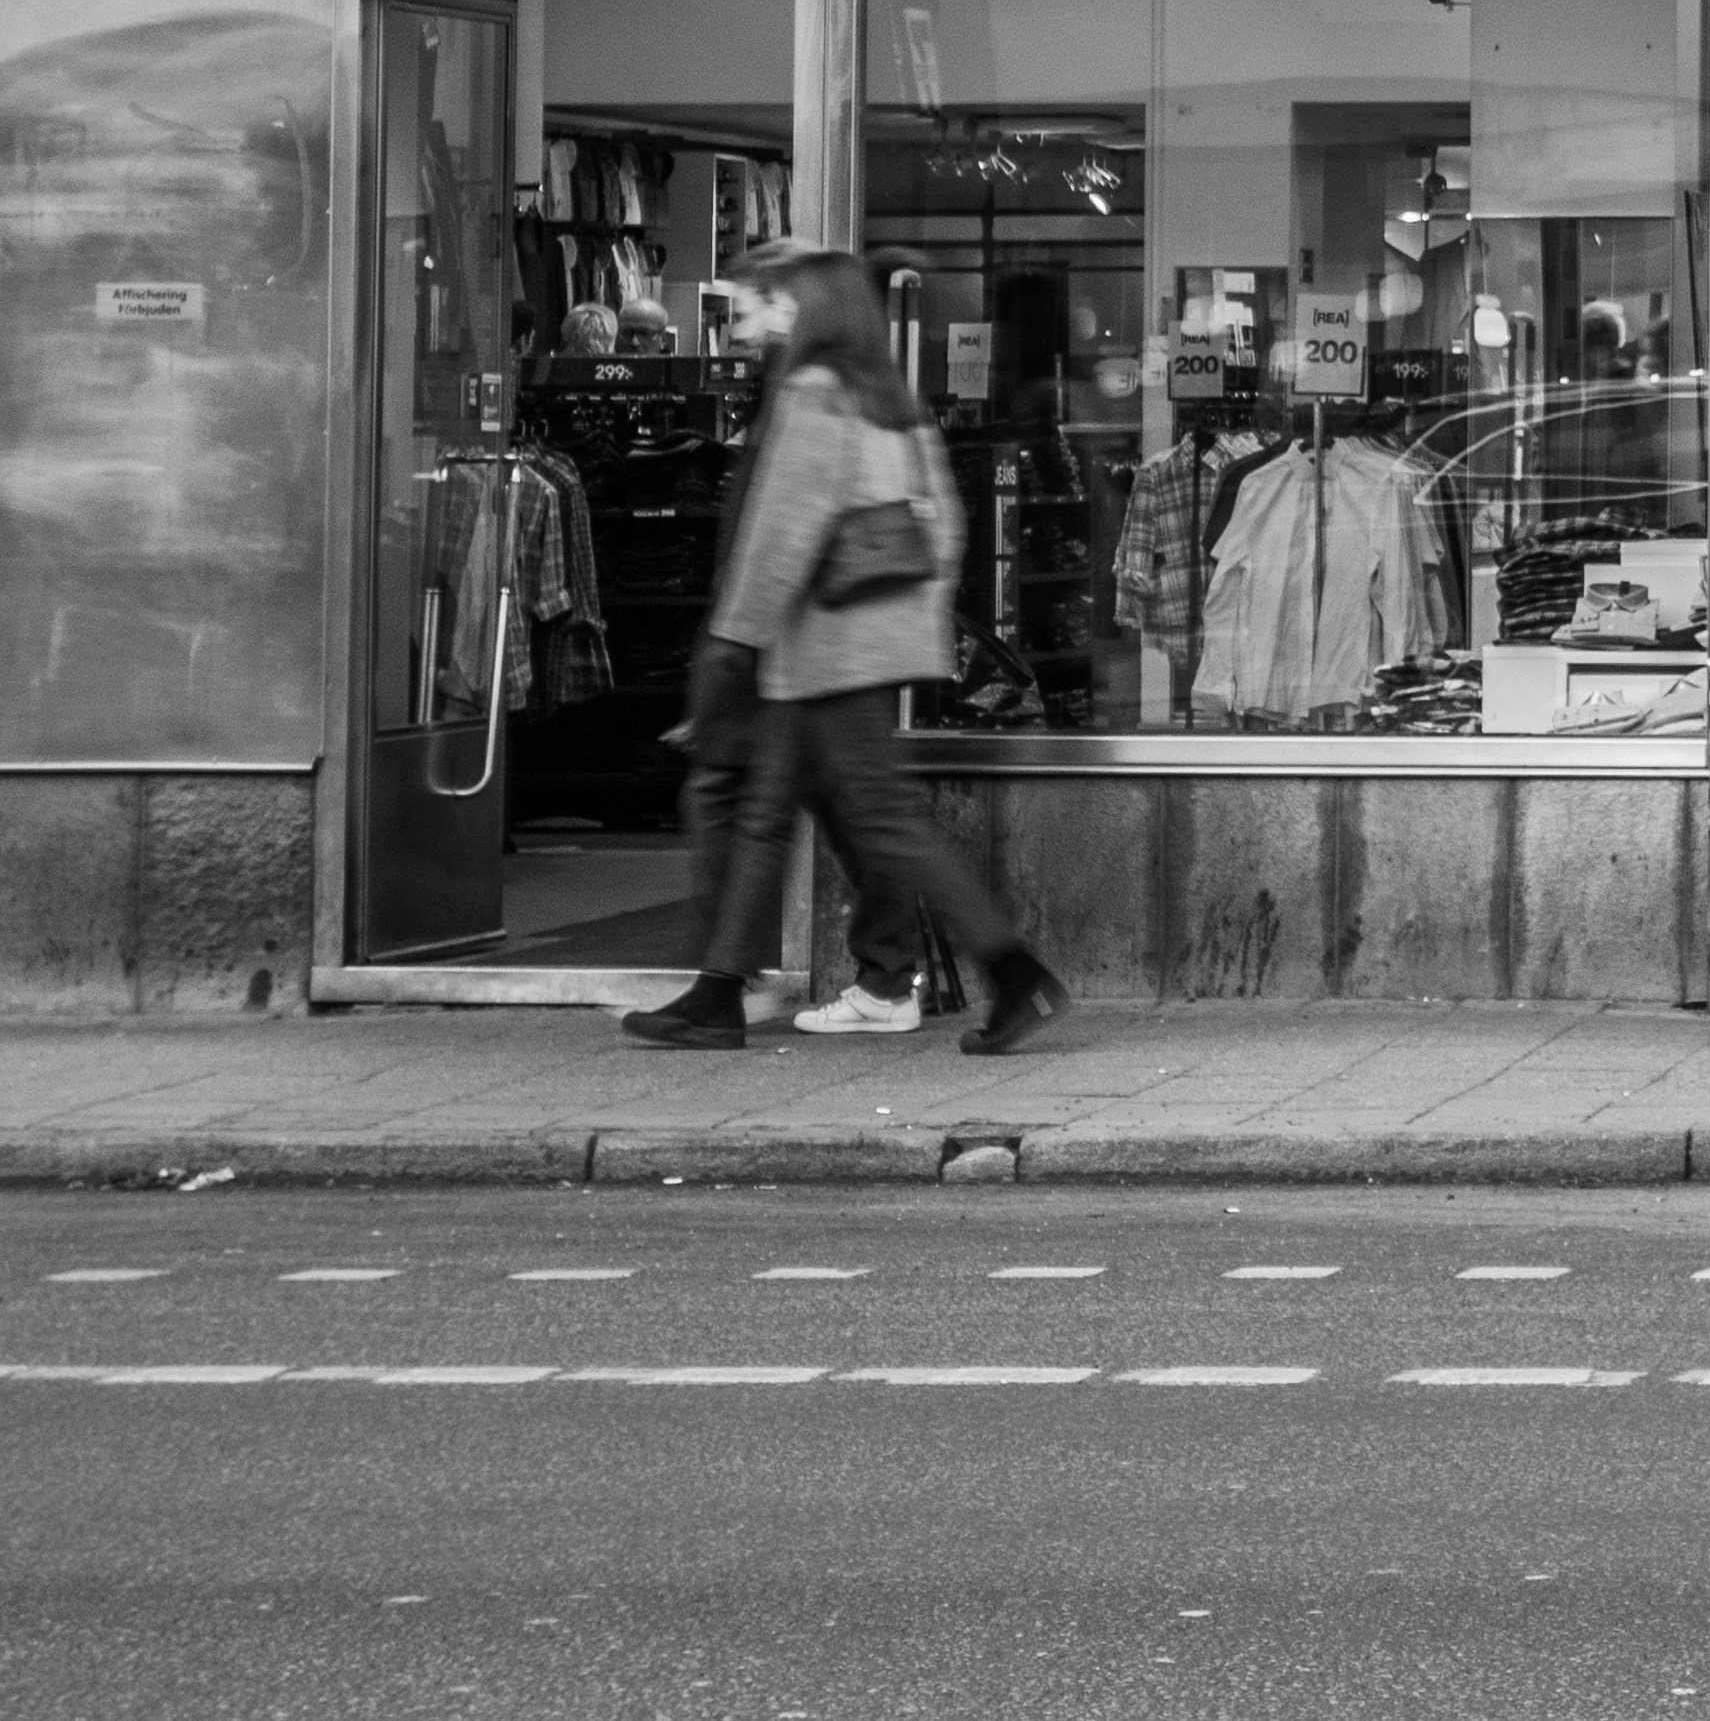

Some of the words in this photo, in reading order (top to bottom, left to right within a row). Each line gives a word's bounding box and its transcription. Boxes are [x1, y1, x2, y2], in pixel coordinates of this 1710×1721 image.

[112, 289, 188, 303] Affischering
[1304, 339, 1358, 365] 200
[1174, 355, 1219, 376] 200
